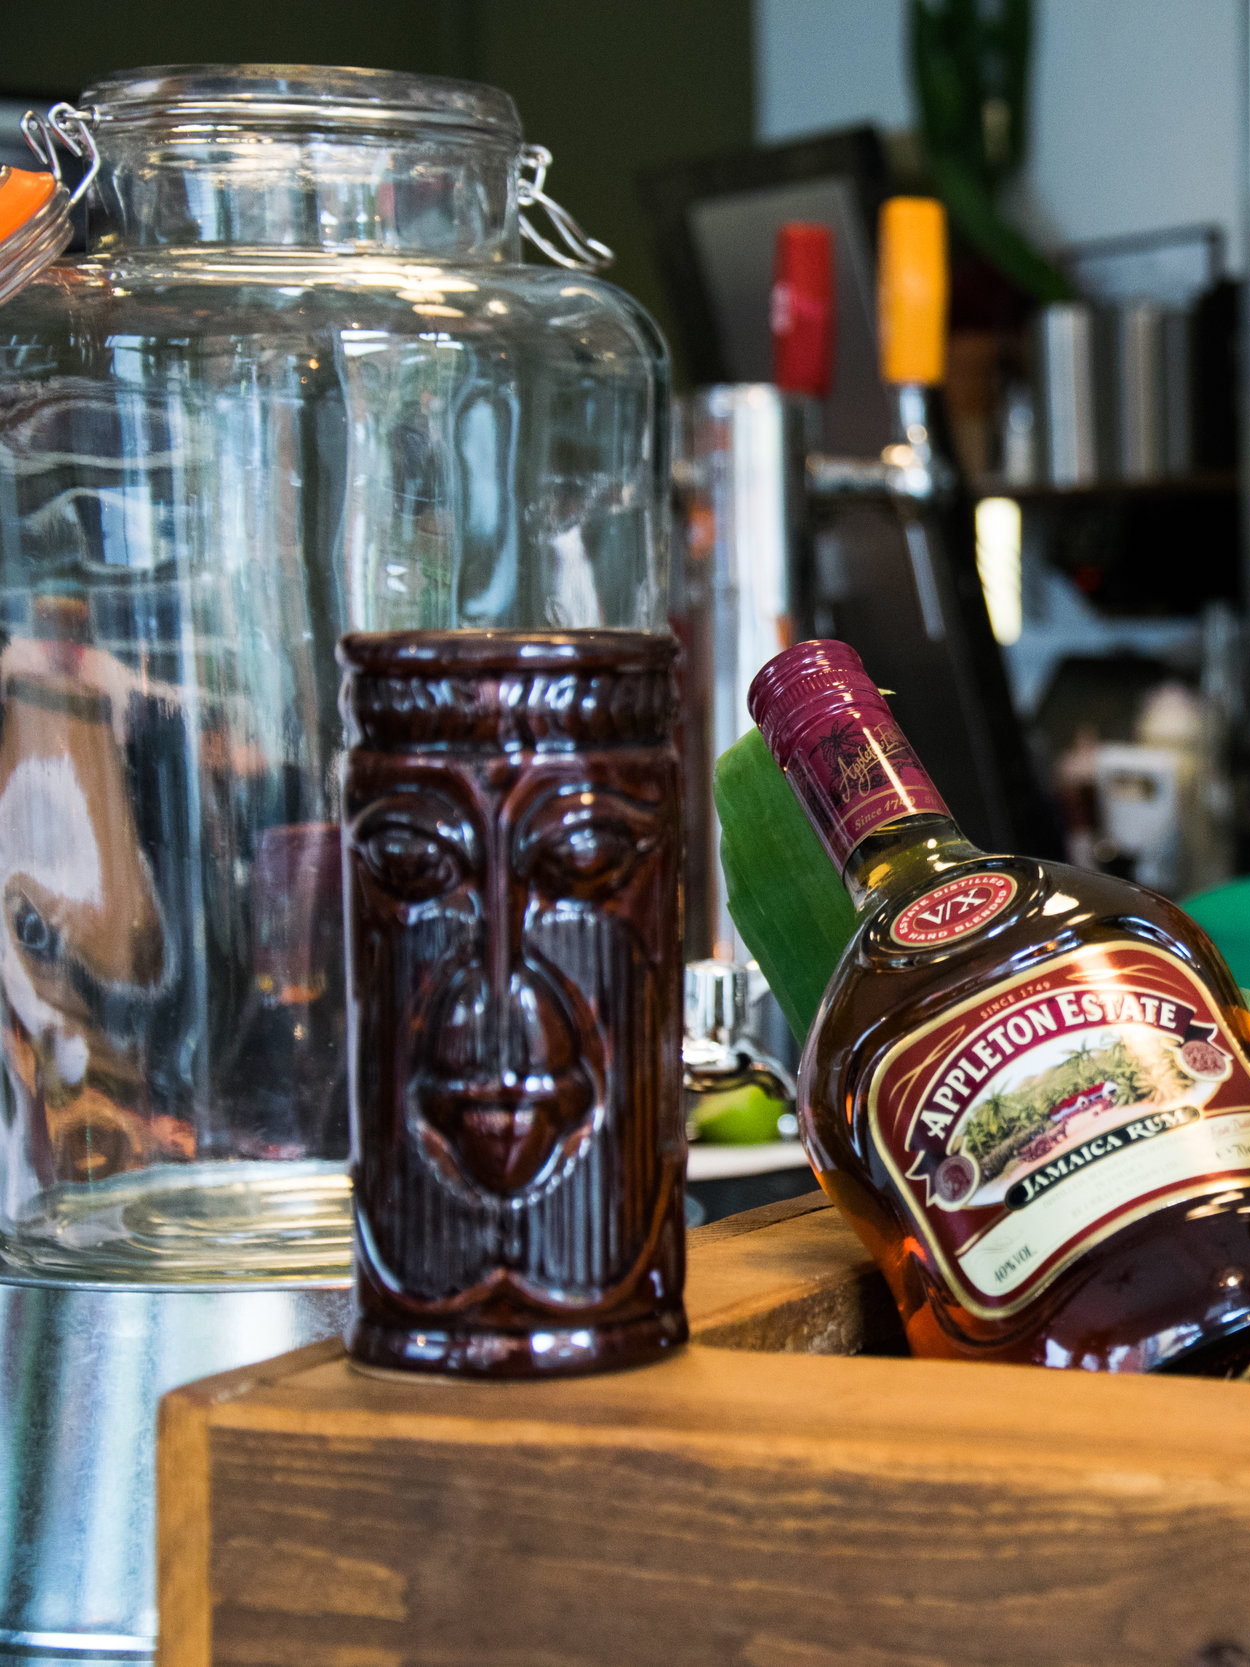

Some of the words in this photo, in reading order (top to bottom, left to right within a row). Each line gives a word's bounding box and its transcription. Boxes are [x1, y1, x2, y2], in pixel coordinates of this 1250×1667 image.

[854, 807, 882, 832] Since
[899, 899, 929, 934] ESTATE
[933, 877, 1005, 898] DISTILLED
[908, 930, 948, 940] HAND
[954, 889, 1007, 933] BLENDED
[917, 887, 987, 925] V/X
[980, 994, 1015, 1019] SINCE
[1020, 981, 1051, 997] 1749
[920, 1003, 1058, 1140] APPLETON
[1054, 992, 1178, 1029] ESTATE
[1021, 1134, 1123, 1201] JAMAICA
[1127, 1108, 1187, 1140] RUM
